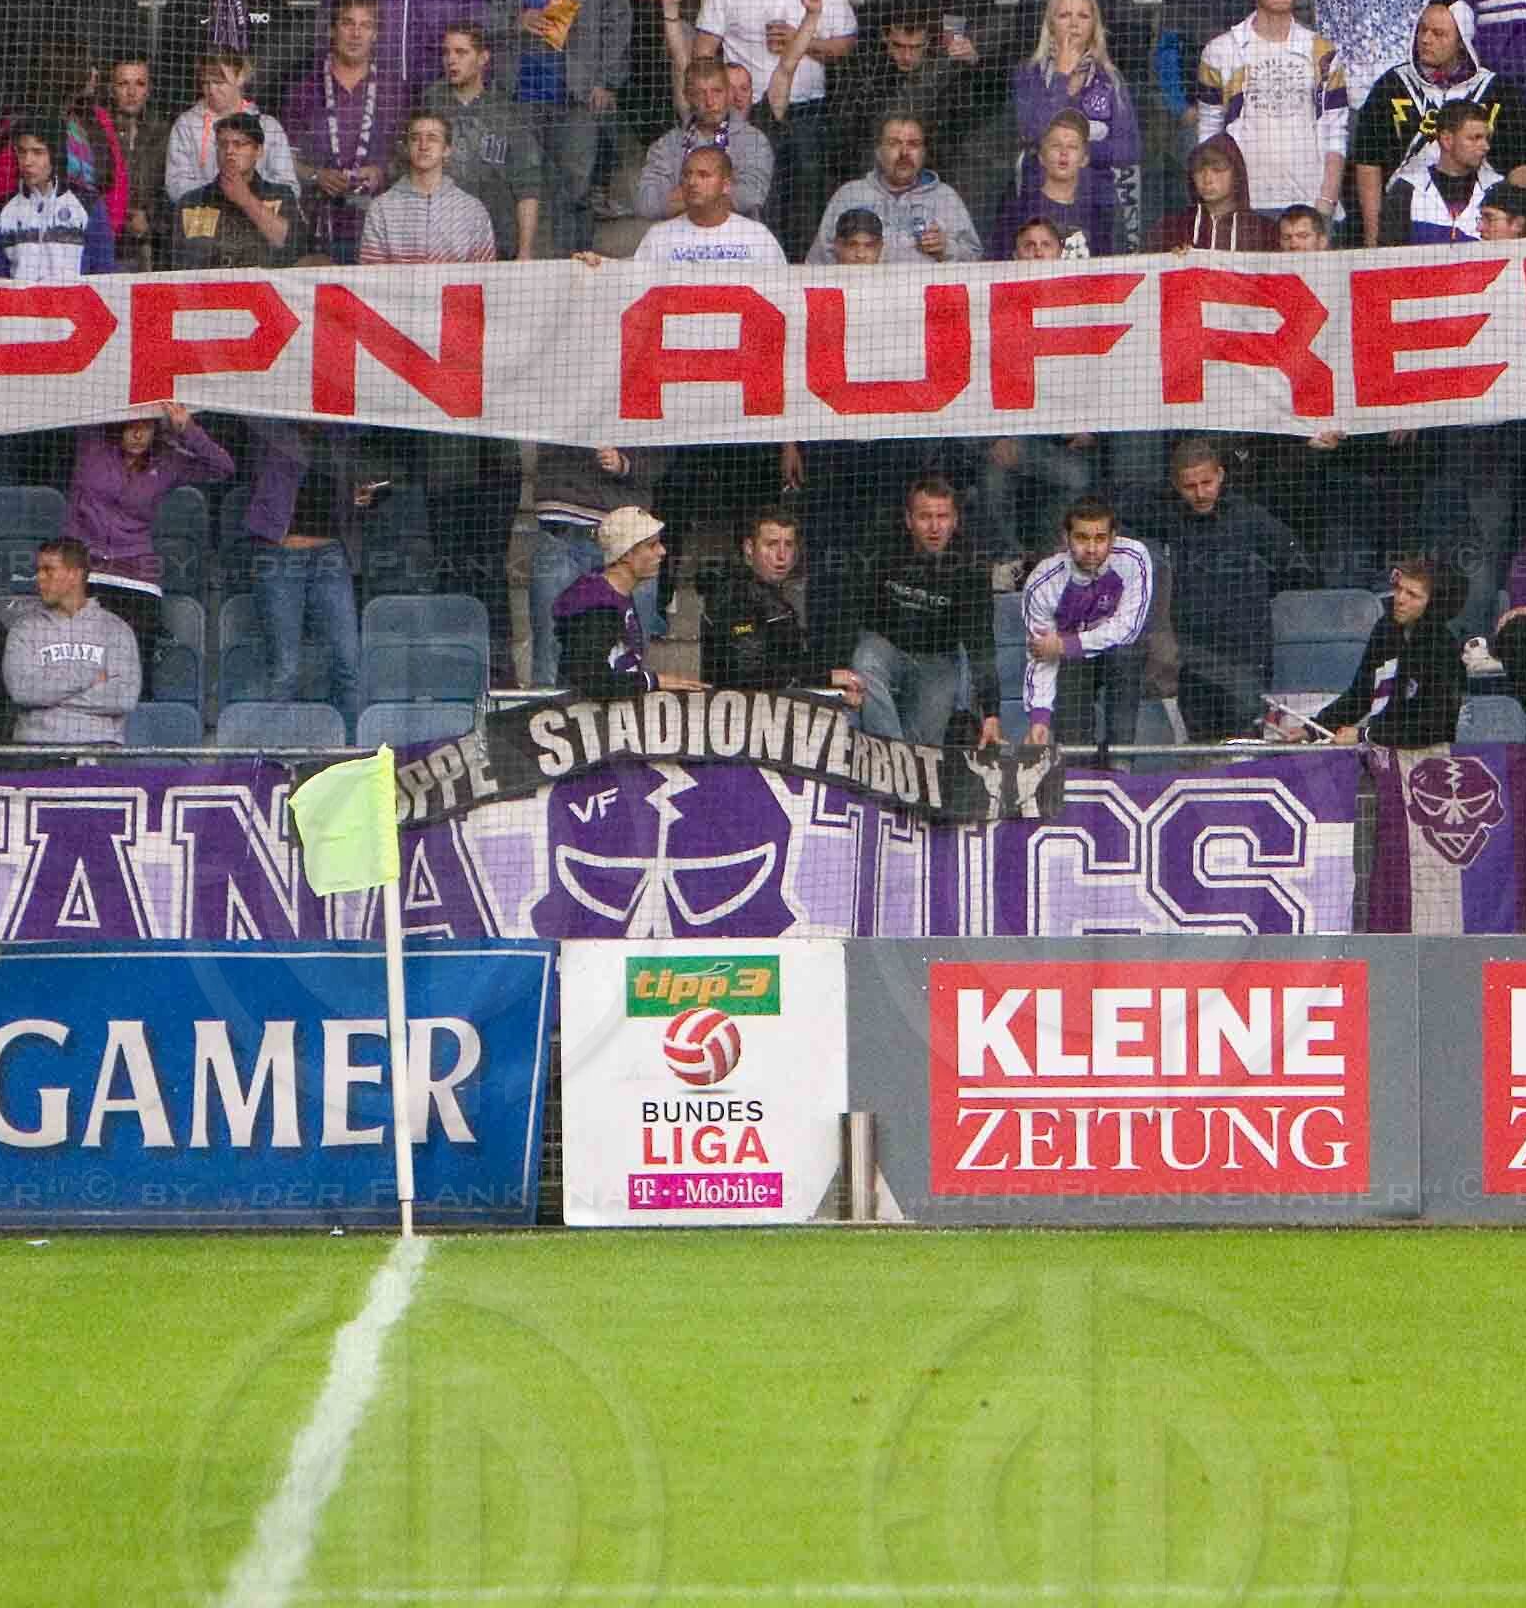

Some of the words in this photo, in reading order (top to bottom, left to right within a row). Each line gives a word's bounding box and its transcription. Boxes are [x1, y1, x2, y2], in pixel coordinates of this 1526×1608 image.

[529, 689, 945, 808] STADIONVERBOT
[568, 787, 619, 824] VF
[957, 987, 1345, 1077] KLEINE
[642, 1100, 763, 1123] BUNDES
[642, 1125, 769, 1165] LIGA
[957, 1106, 1349, 1172] ZEITUNG
